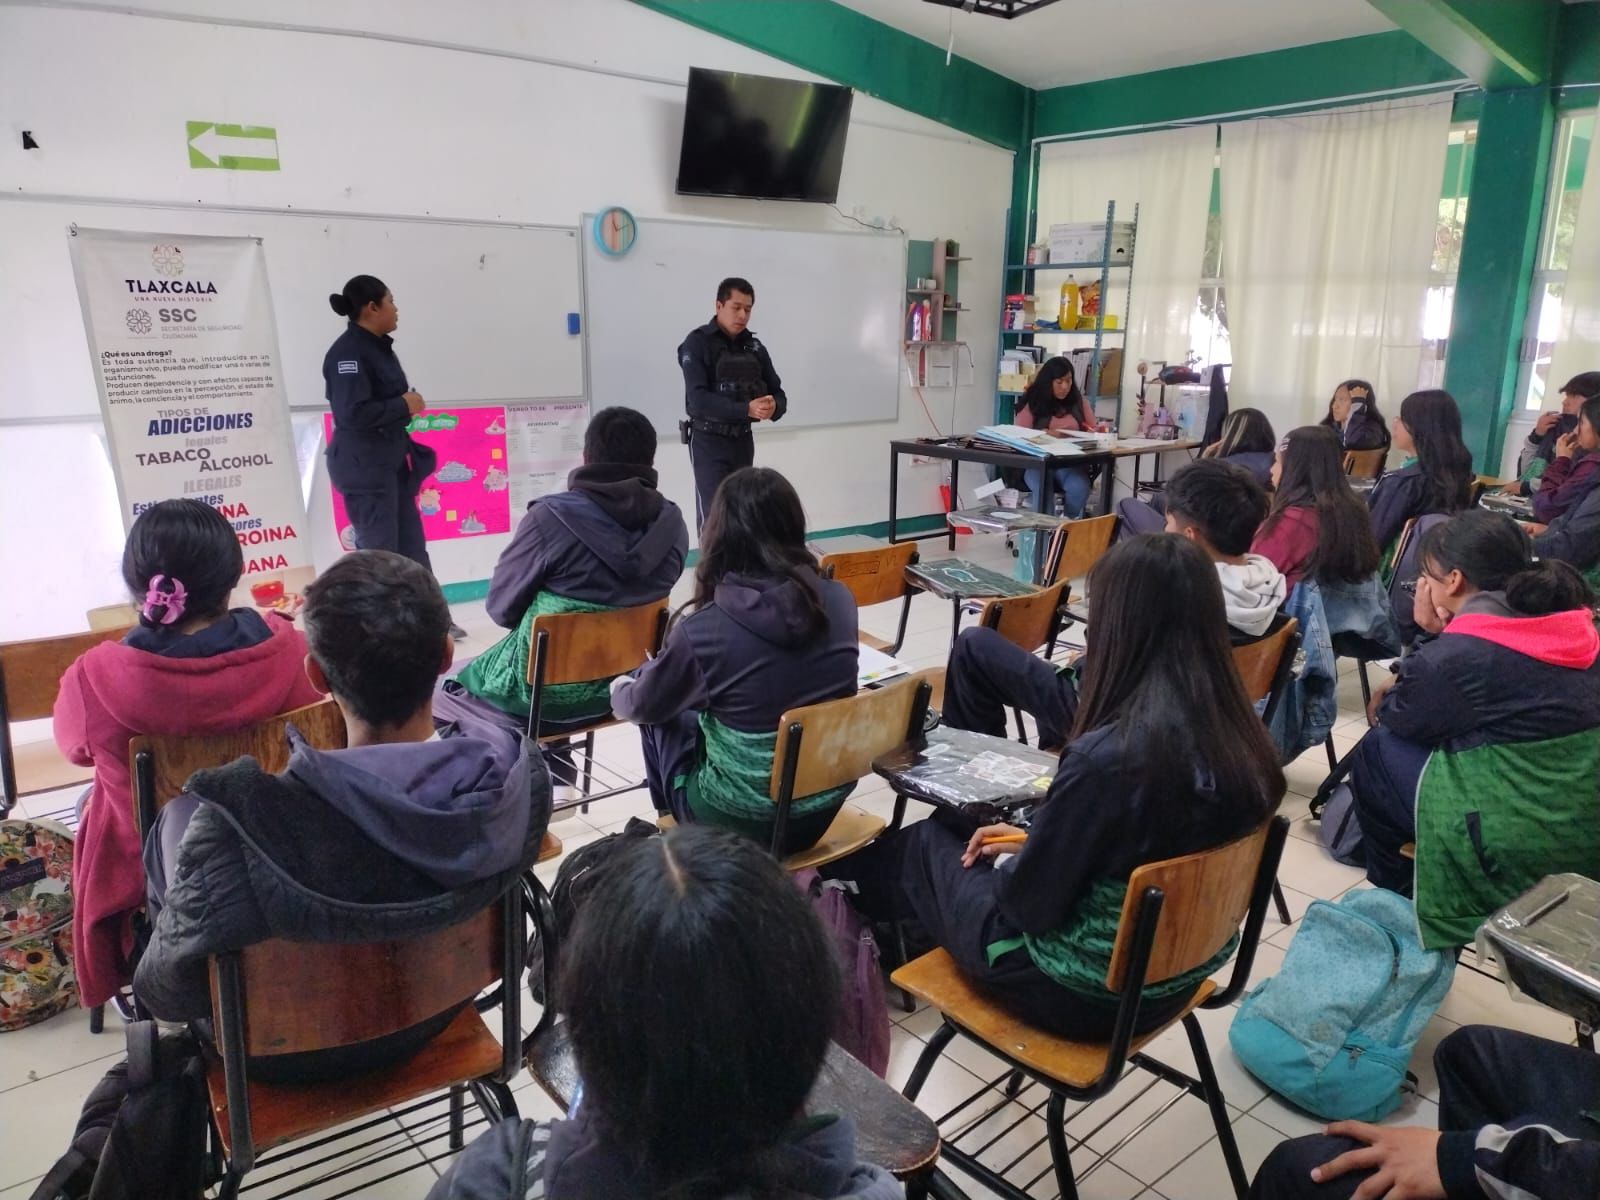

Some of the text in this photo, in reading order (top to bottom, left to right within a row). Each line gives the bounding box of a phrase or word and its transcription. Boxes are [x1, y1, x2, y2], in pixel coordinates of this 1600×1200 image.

[125, 280, 218, 294] TLAXCALA
[158, 308, 197, 322] SSC
[101, 350, 119, 358] ¿Qué
[146, 350, 172, 358] droga?
[201, 354, 247, 362] introducida
[104, 366, 143, 374] organismo
[144, 380, 191, 388] dependencia
[108, 389, 138, 397] producir
[142, 394, 182, 402] conciencia
[157, 407, 208, 418] TIPOS DE
[148, 412, 253, 436] ADICCIONES
[186, 434, 228, 448] legales
[136, 448, 210, 466] TABACO
[200, 452, 273, 472] ALCOHOL
[184, 474, 242, 494] ILEGALES
[217, 502, 249, 518] INA
[237, 524, 297, 546] ROINA
[242, 554, 288, 574] ANA
